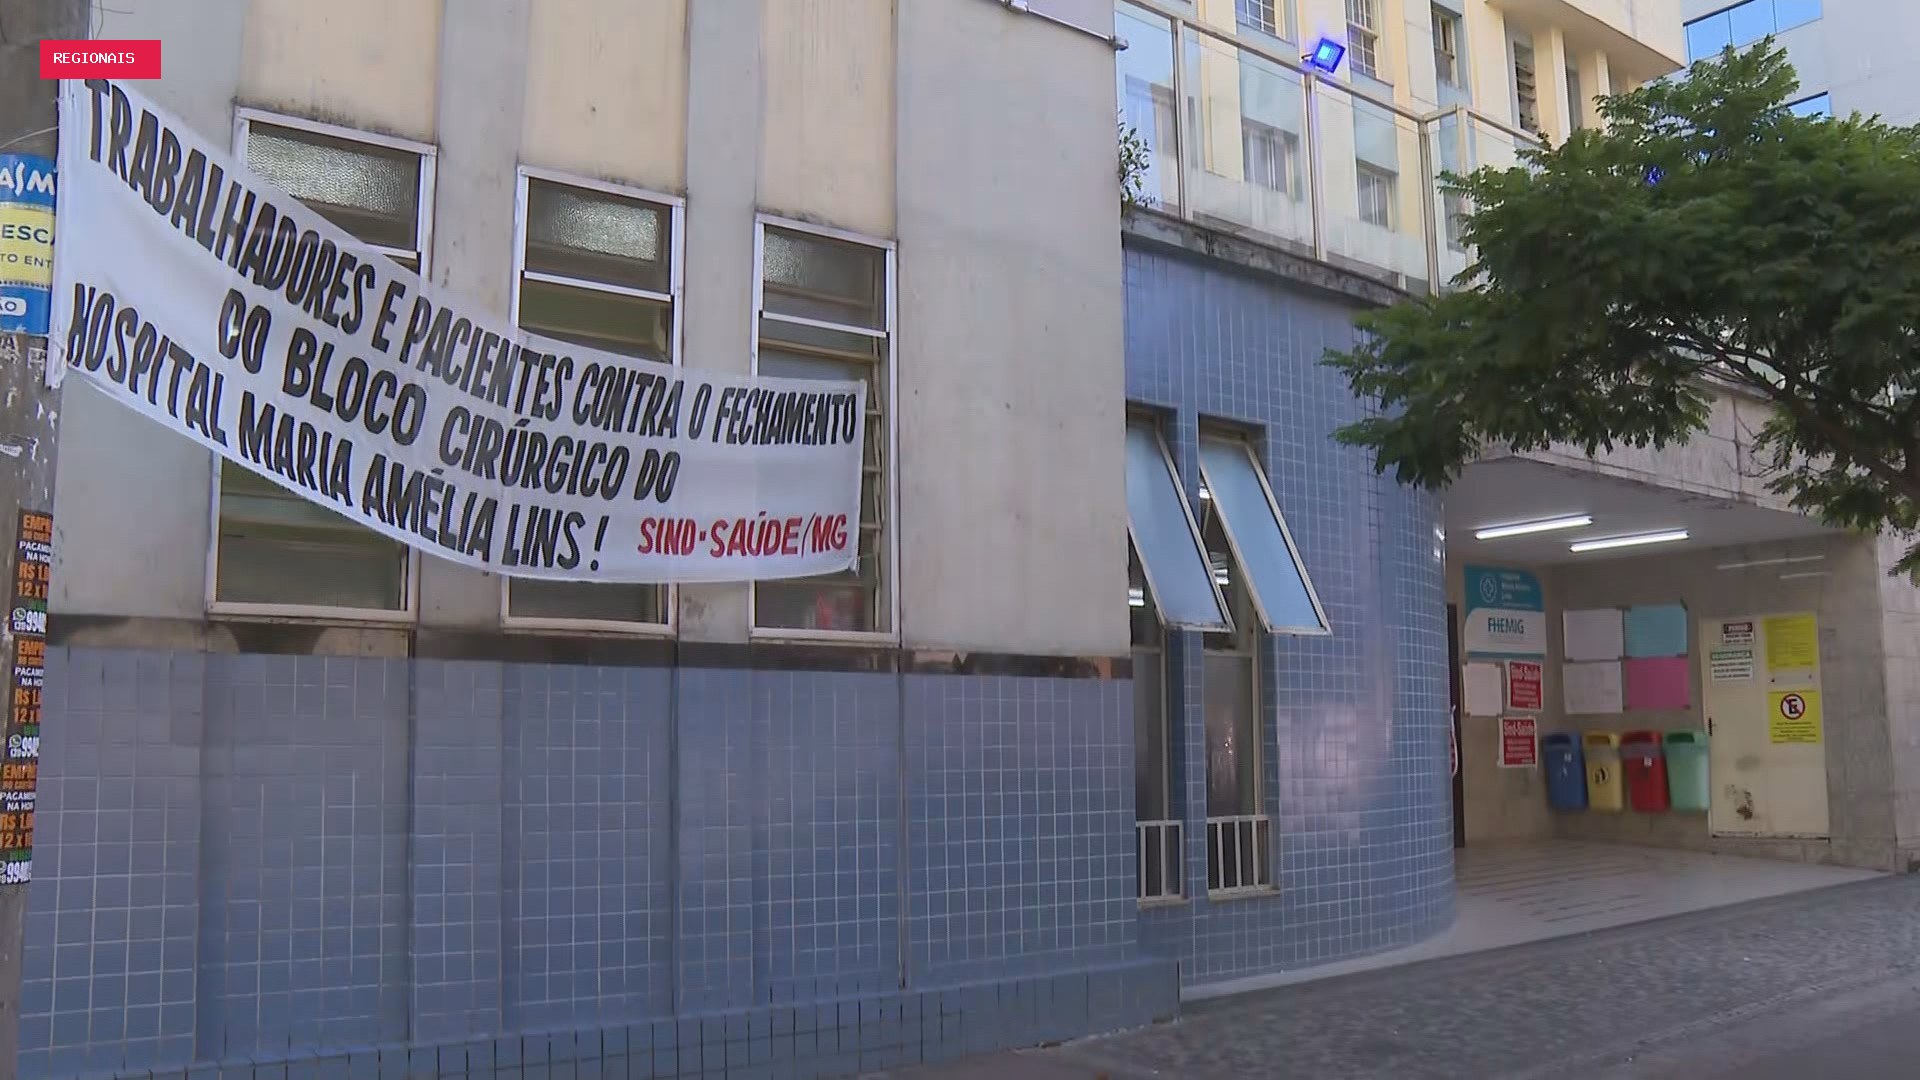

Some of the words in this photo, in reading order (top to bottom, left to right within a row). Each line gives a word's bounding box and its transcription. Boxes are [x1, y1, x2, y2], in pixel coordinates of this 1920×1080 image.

[84, 78, 376, 336] TRABALHADORES
[371, 280, 406, 353] E
[399, 296, 574, 422] PACIENTES
[573, 362, 684, 440] CONTRA
[688, 382, 712, 441] O
[711, 386, 857, 447] FECHAMENTO
[66, 283, 228, 448] HOSPITAL
[238, 390, 353, 508] MARIA
[361, 454, 498, 564] AMÉLIA
[282, 327, 427, 447] BLOCO
[439, 405, 629, 501] CIRÚRGICO
[633, 448, 681, 504] DO
[1487, 617, 1525, 634] FHEMIG
